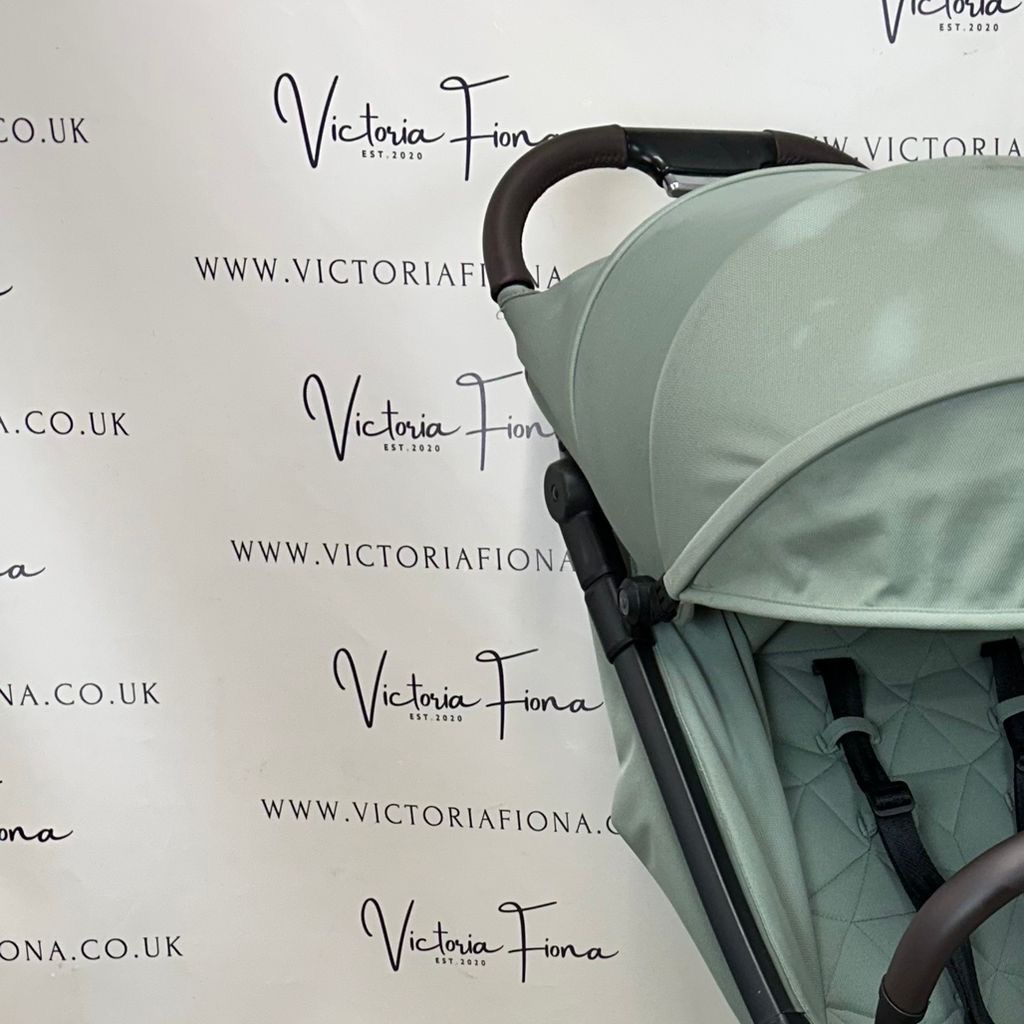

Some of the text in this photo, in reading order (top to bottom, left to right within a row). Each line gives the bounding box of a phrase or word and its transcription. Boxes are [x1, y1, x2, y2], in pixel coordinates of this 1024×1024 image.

[939, 23, 998, 32] EST.2020
[274, 73, 445, 169] Victoria
[362, 150, 422, 160] EST.2020
[303, 374, 461, 462] Victoria
[384, 444, 440, 452] EST.2020
[333, 647, 604, 740] Victoria Fiona
[410, 713, 462, 722] EST.2020
[361, 898, 619, 983] Victoria Fiona
[435, 957, 485, 966] EST.2020
